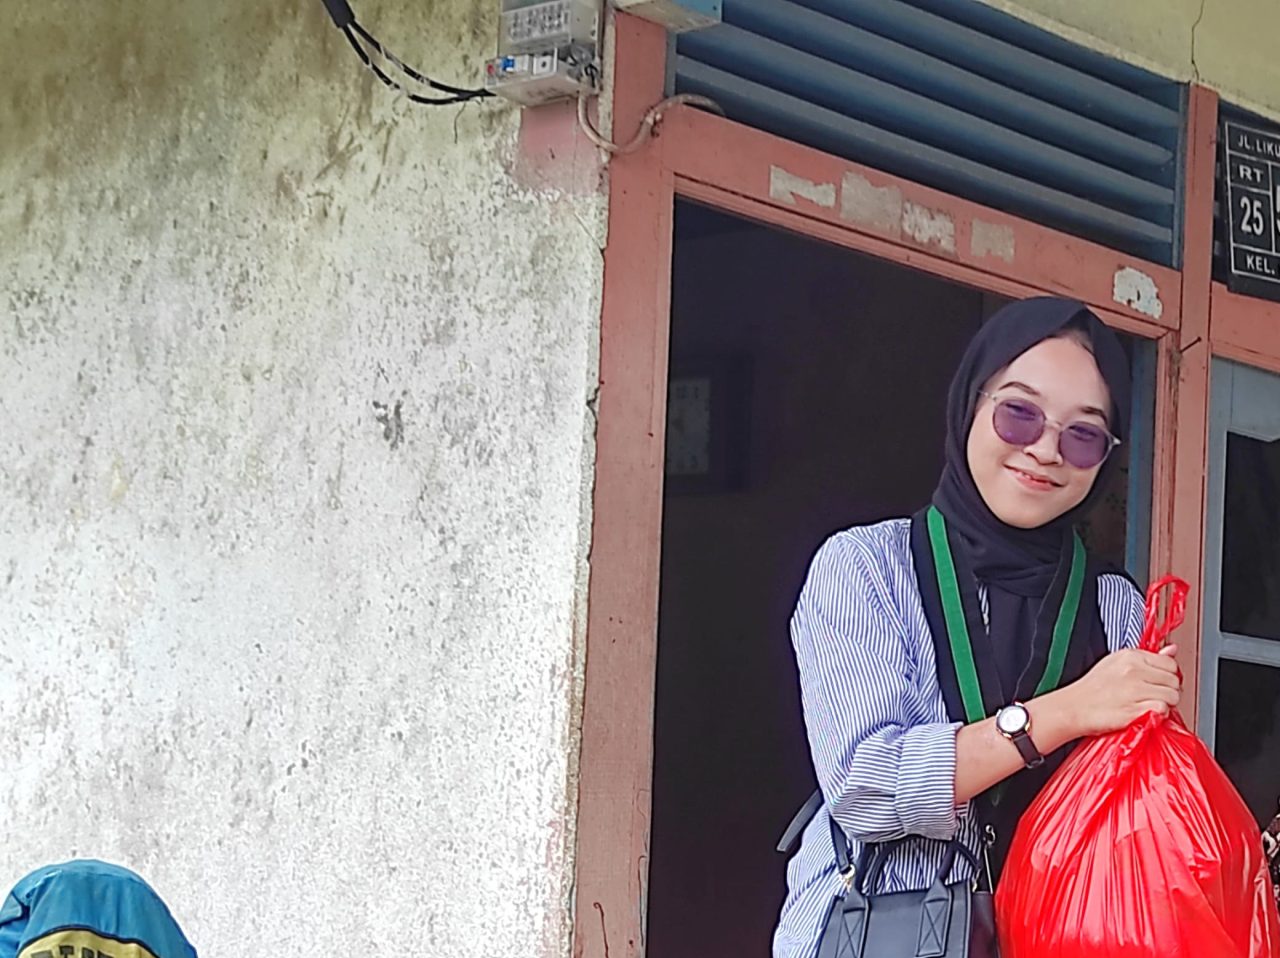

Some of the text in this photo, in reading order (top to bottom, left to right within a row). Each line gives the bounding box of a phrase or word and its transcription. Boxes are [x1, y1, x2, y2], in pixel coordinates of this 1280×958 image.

[1239, 164, 1263, 182] RT
[1240, 196, 1264, 235] 25
[1246, 254, 1275, 275] KEL.
